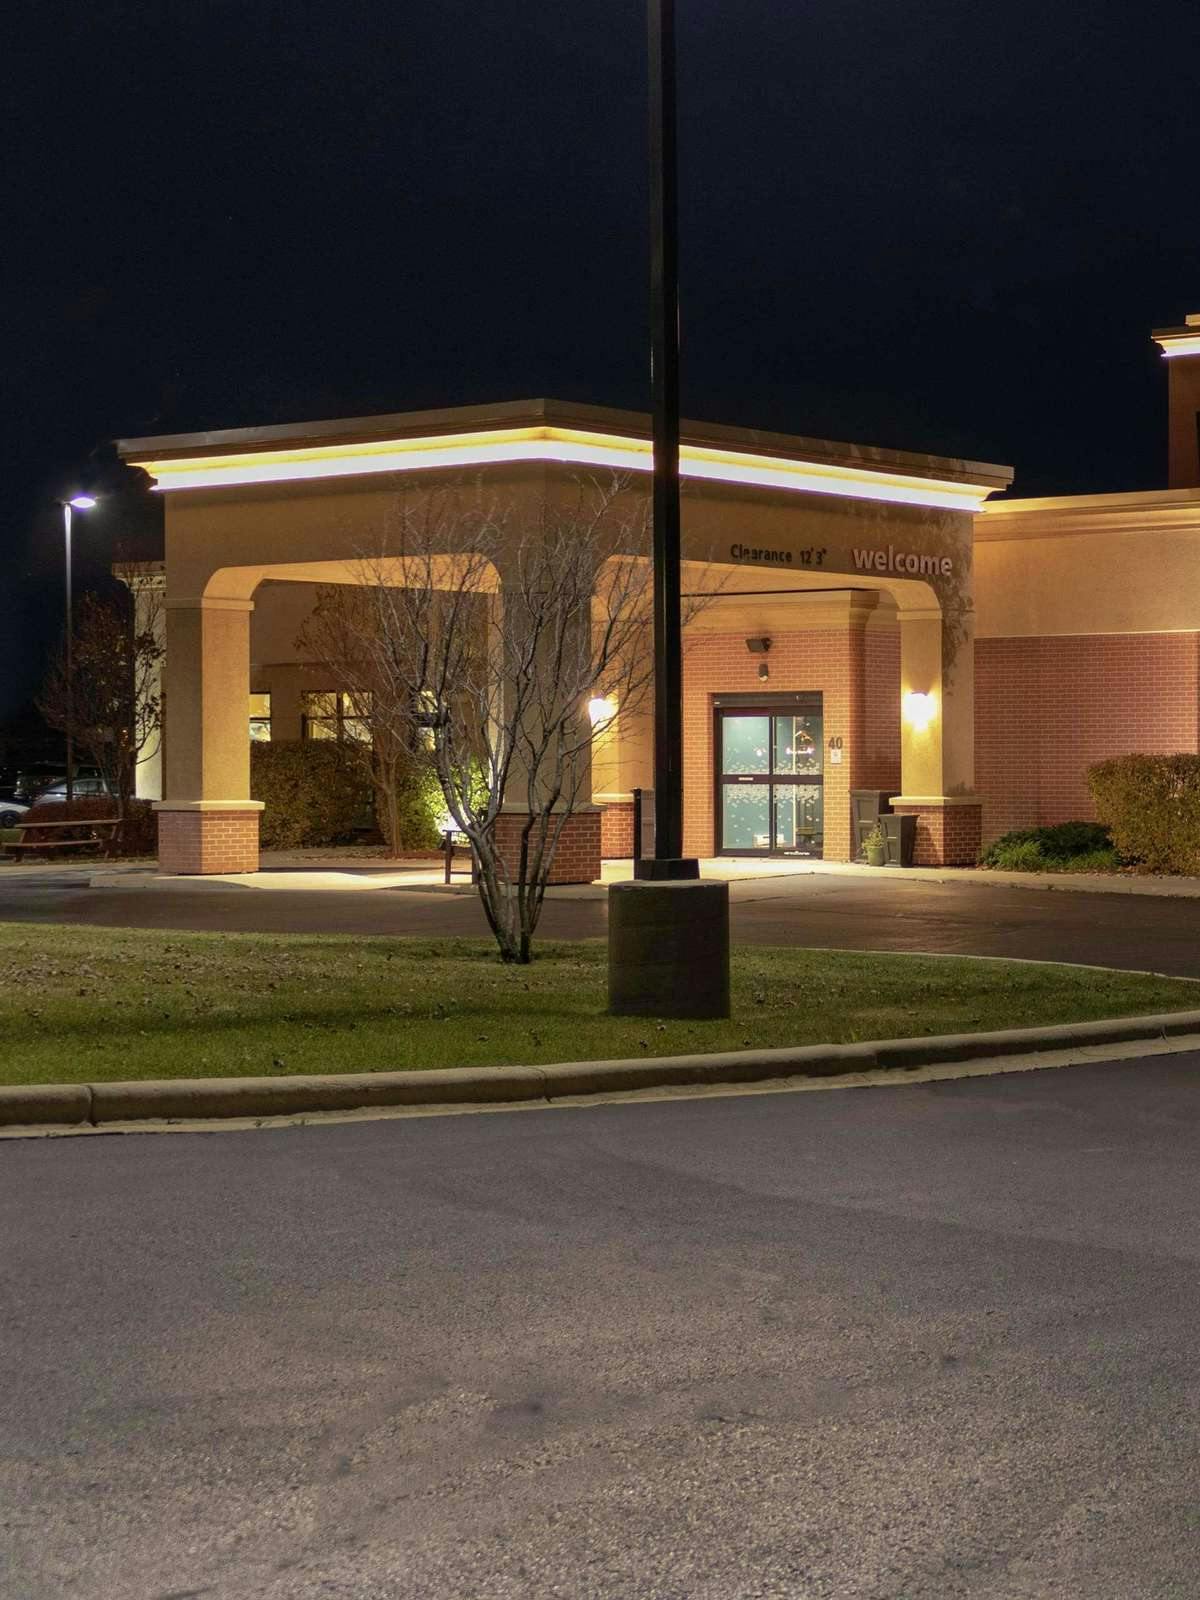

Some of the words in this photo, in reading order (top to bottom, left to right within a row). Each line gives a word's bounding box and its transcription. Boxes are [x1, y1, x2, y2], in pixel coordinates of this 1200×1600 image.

[730, 543, 793, 562] Clearance
[853, 544, 953, 577] welcome
[828, 736, 844, 750] 40
